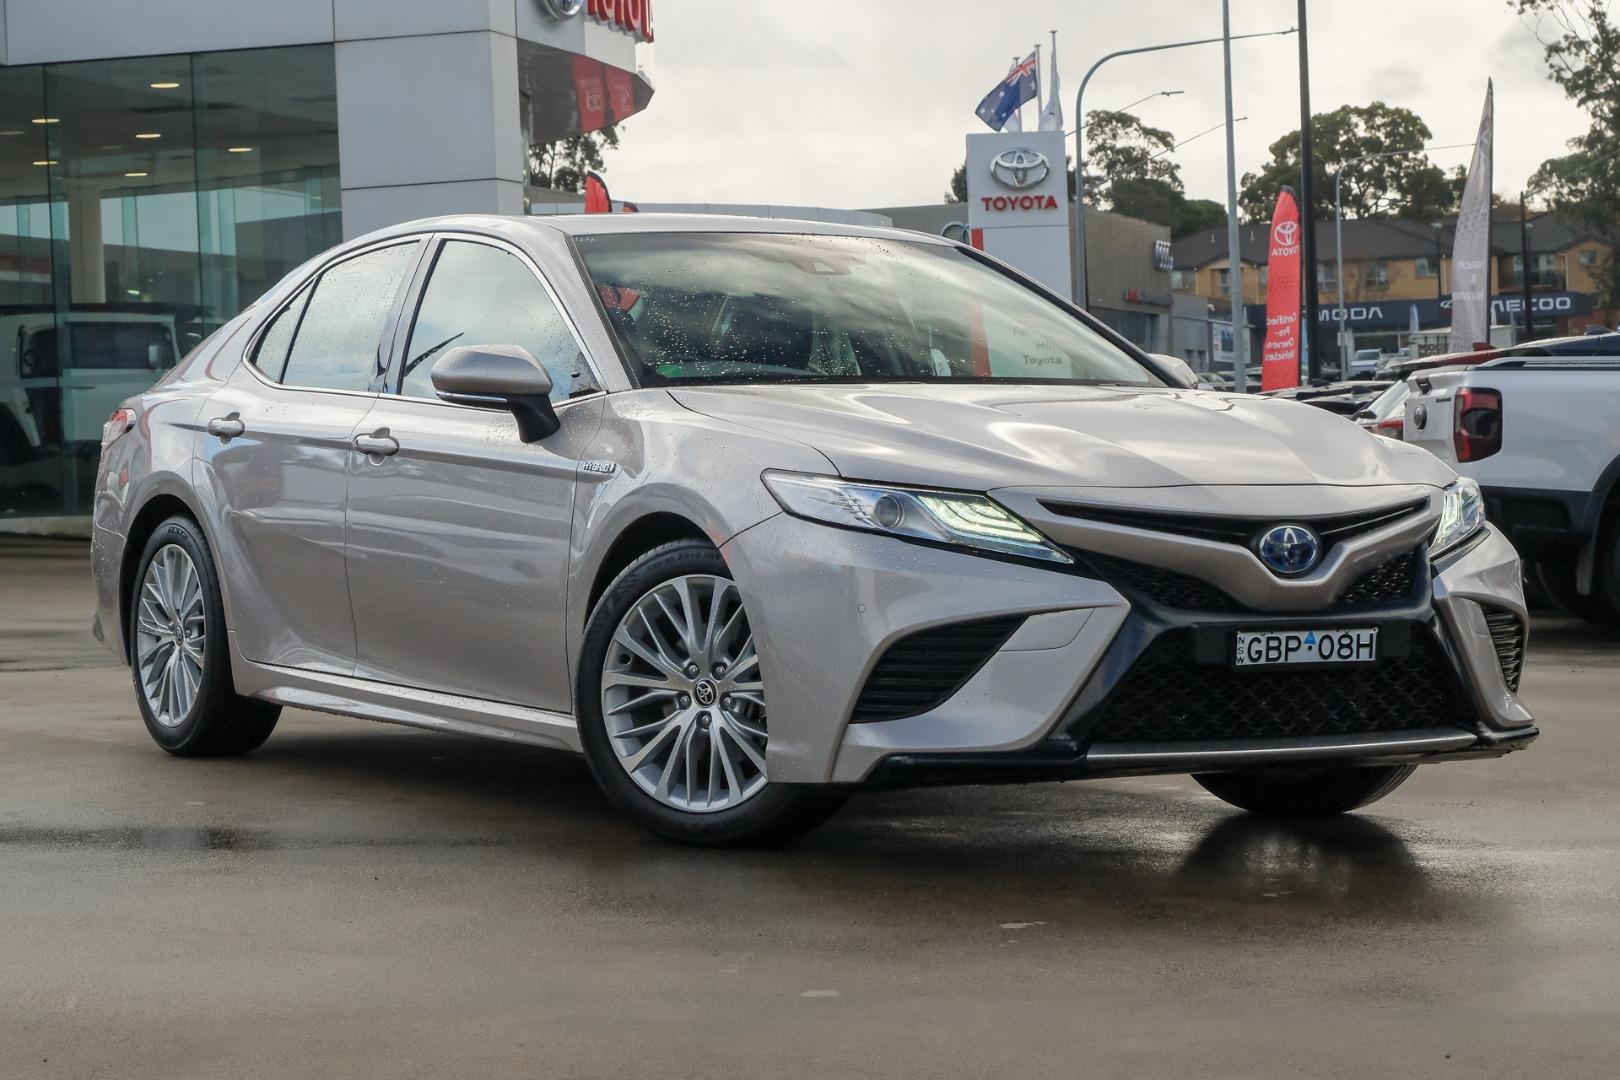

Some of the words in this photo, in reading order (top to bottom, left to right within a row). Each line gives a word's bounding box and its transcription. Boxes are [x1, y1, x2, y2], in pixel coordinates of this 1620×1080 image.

[981, 195, 1058, 212] TOYOTA
[1022, 354, 1062, 366] Toyota
[1247, 635, 1302, 663] GBP
[1317, 633, 1374, 660] 08H
